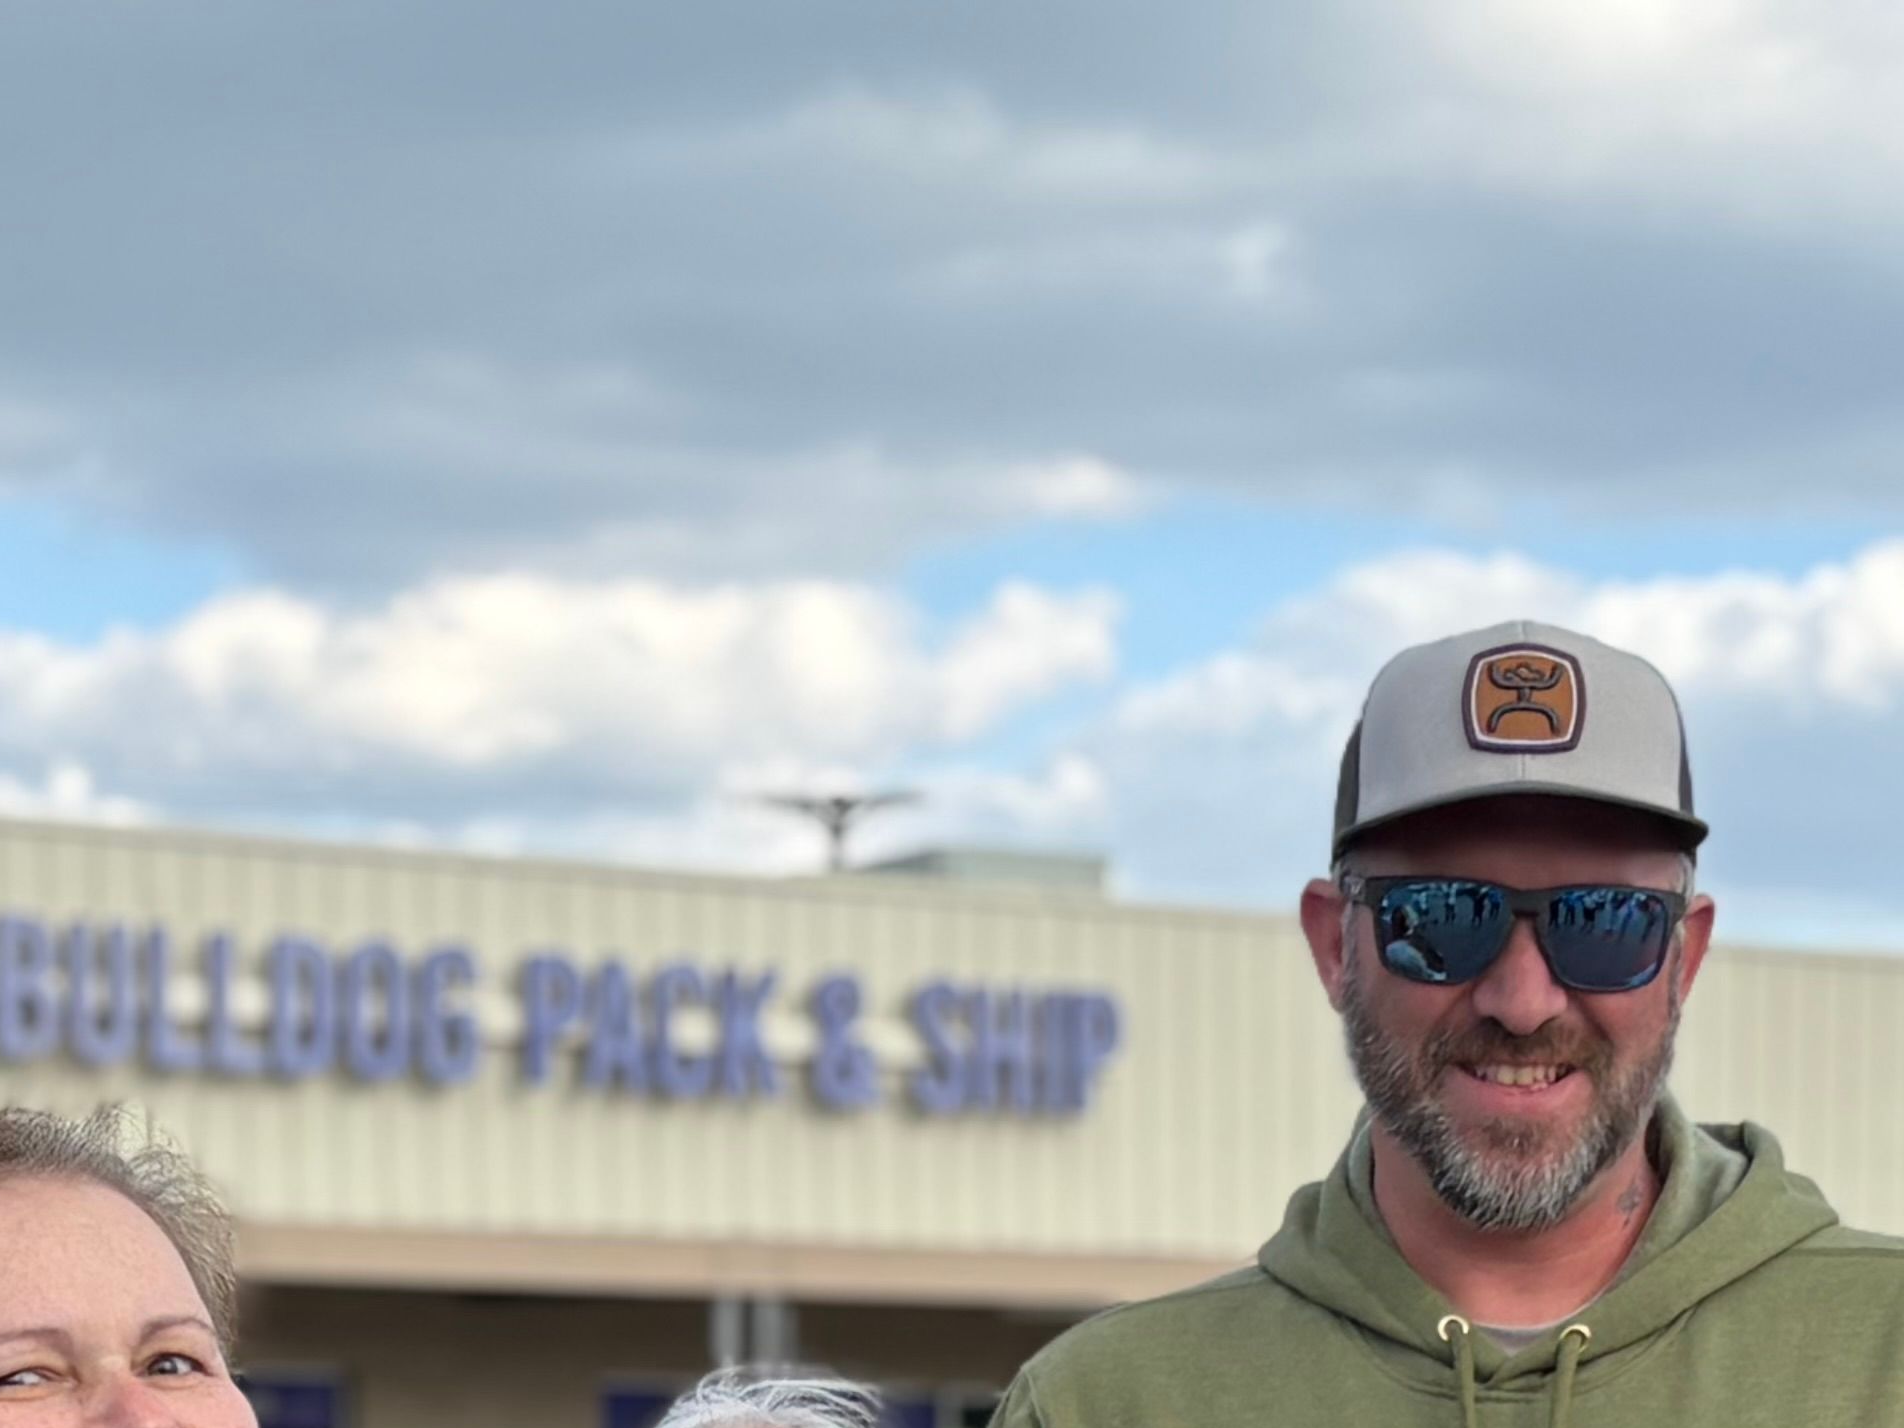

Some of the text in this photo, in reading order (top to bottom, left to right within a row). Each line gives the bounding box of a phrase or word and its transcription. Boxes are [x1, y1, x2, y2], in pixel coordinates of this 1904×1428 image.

[523, 954, 778, 1098] PACK
[812, 970, 880, 1106] &
[908, 981, 1122, 1116] SHIP
